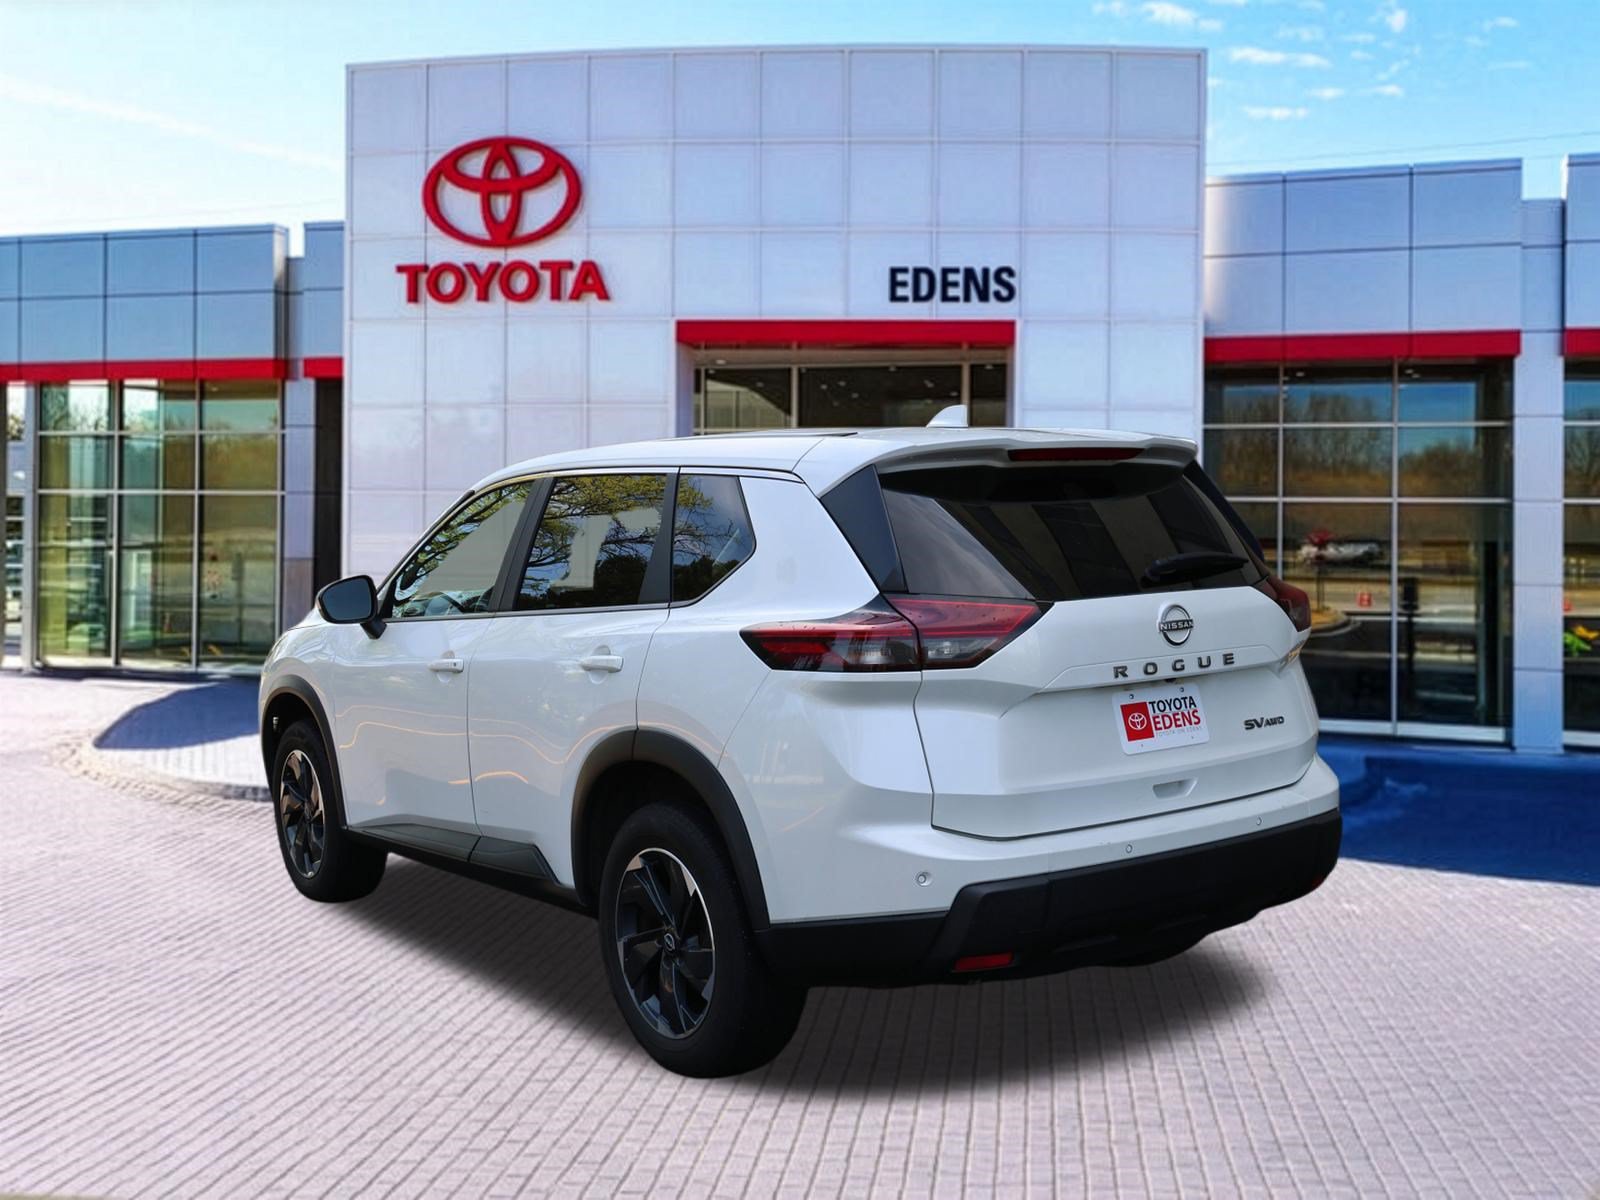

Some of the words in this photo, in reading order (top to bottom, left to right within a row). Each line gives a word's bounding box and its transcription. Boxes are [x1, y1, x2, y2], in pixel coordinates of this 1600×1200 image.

[396, 260, 611, 304] TOYOTA
[889, 266, 1016, 302] EDENS
[1160, 621, 1194, 632] NISSAN
[1113, 652, 1235, 678] ROGUE
[1148, 696, 1197, 713] TOYOTA
[1152, 709, 1201, 731] EDENS
[1244, 717, 1264, 731] SV
[1264, 715, 1285, 728] AWD
